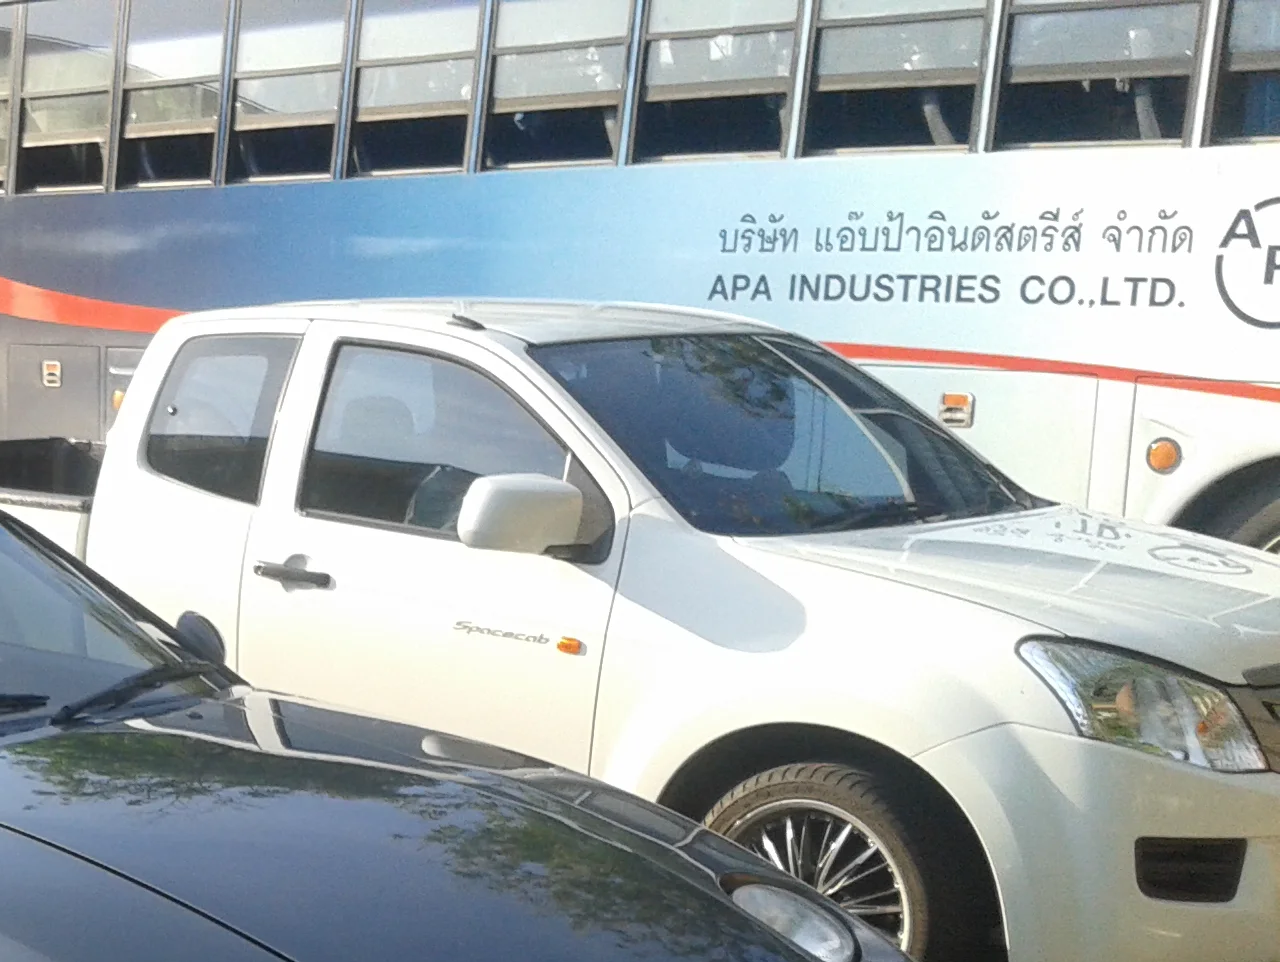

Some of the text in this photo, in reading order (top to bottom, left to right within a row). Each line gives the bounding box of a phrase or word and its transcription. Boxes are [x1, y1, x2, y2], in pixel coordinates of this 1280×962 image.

[718, 213, 799, 253] บริษัท
[1102, 209, 1194, 254] จำกัด
[707, 273, 1186, 308] APA INDUSTRIES CO.,LTD.
[452, 620, 550, 645] Spacecab
